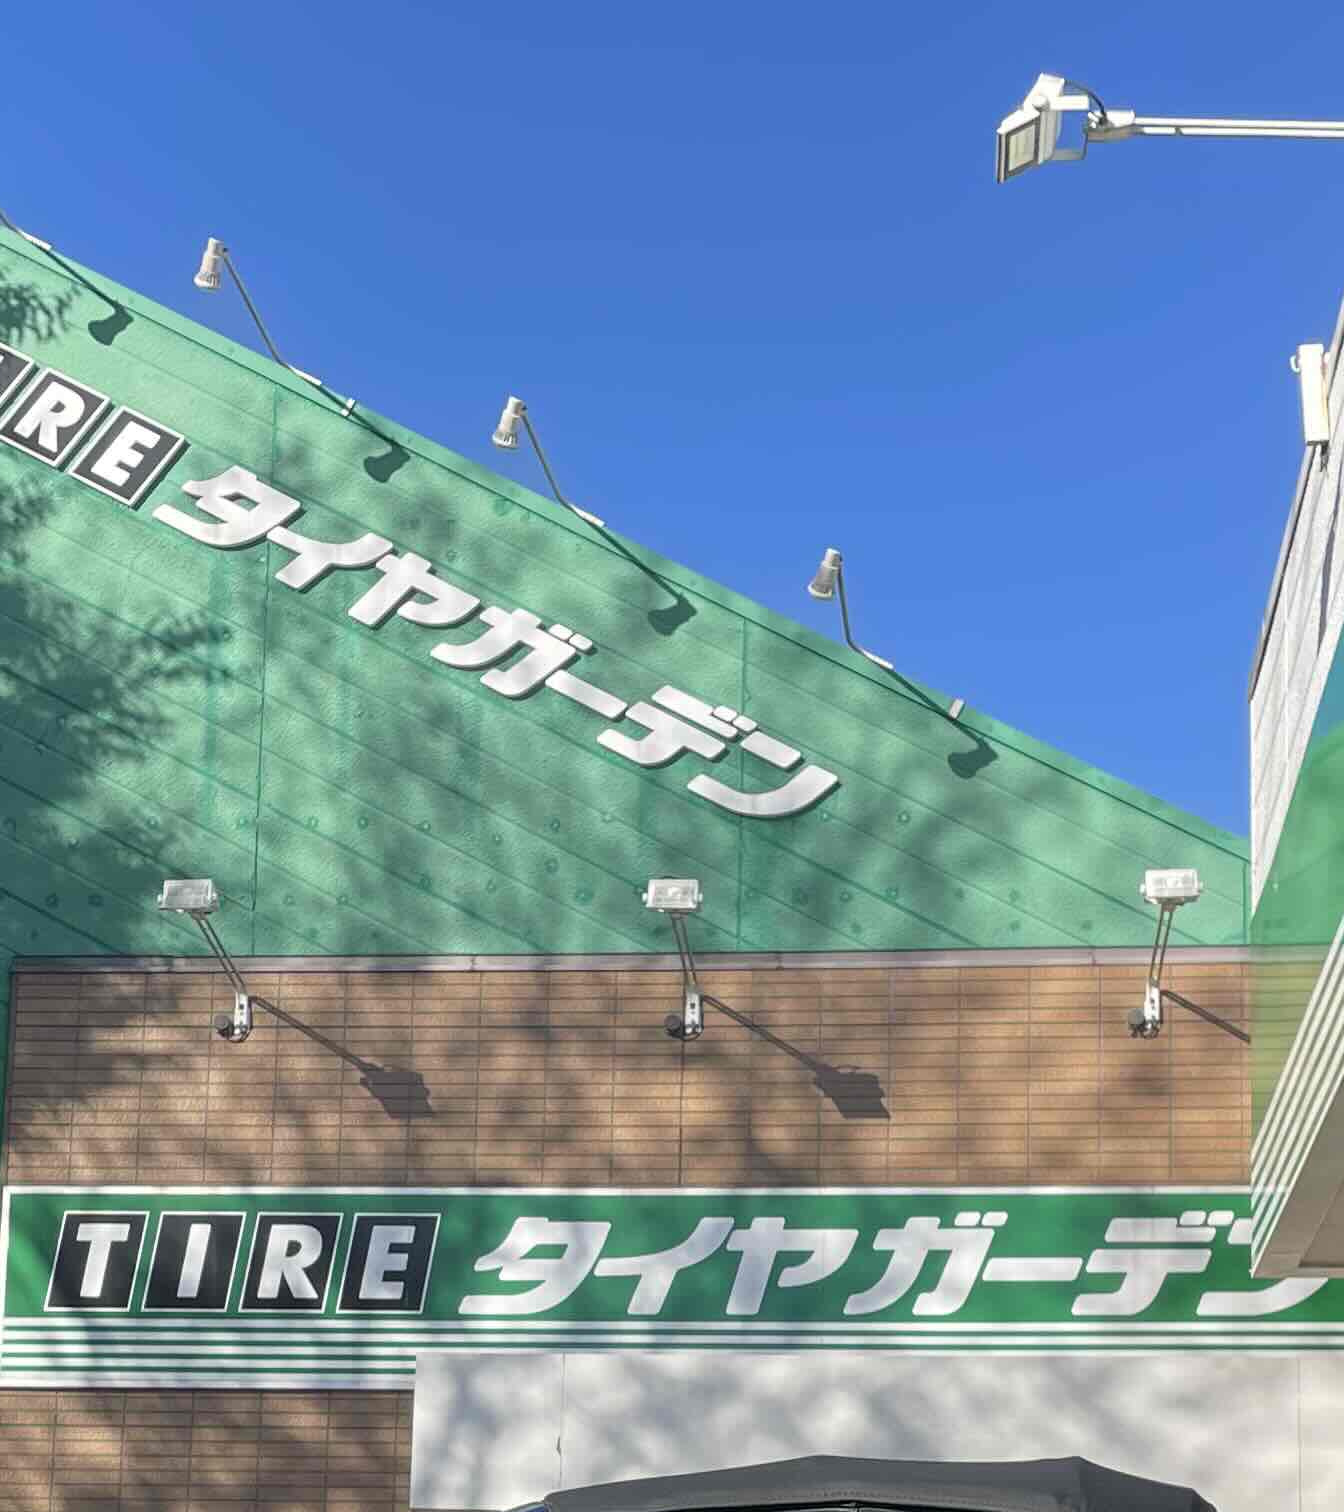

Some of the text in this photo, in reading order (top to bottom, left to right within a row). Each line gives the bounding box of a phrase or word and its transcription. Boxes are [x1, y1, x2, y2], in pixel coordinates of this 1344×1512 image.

[152, 465, 839, 819] タイヤガーデン
[73, 1222, 418, 1306] TIRE
